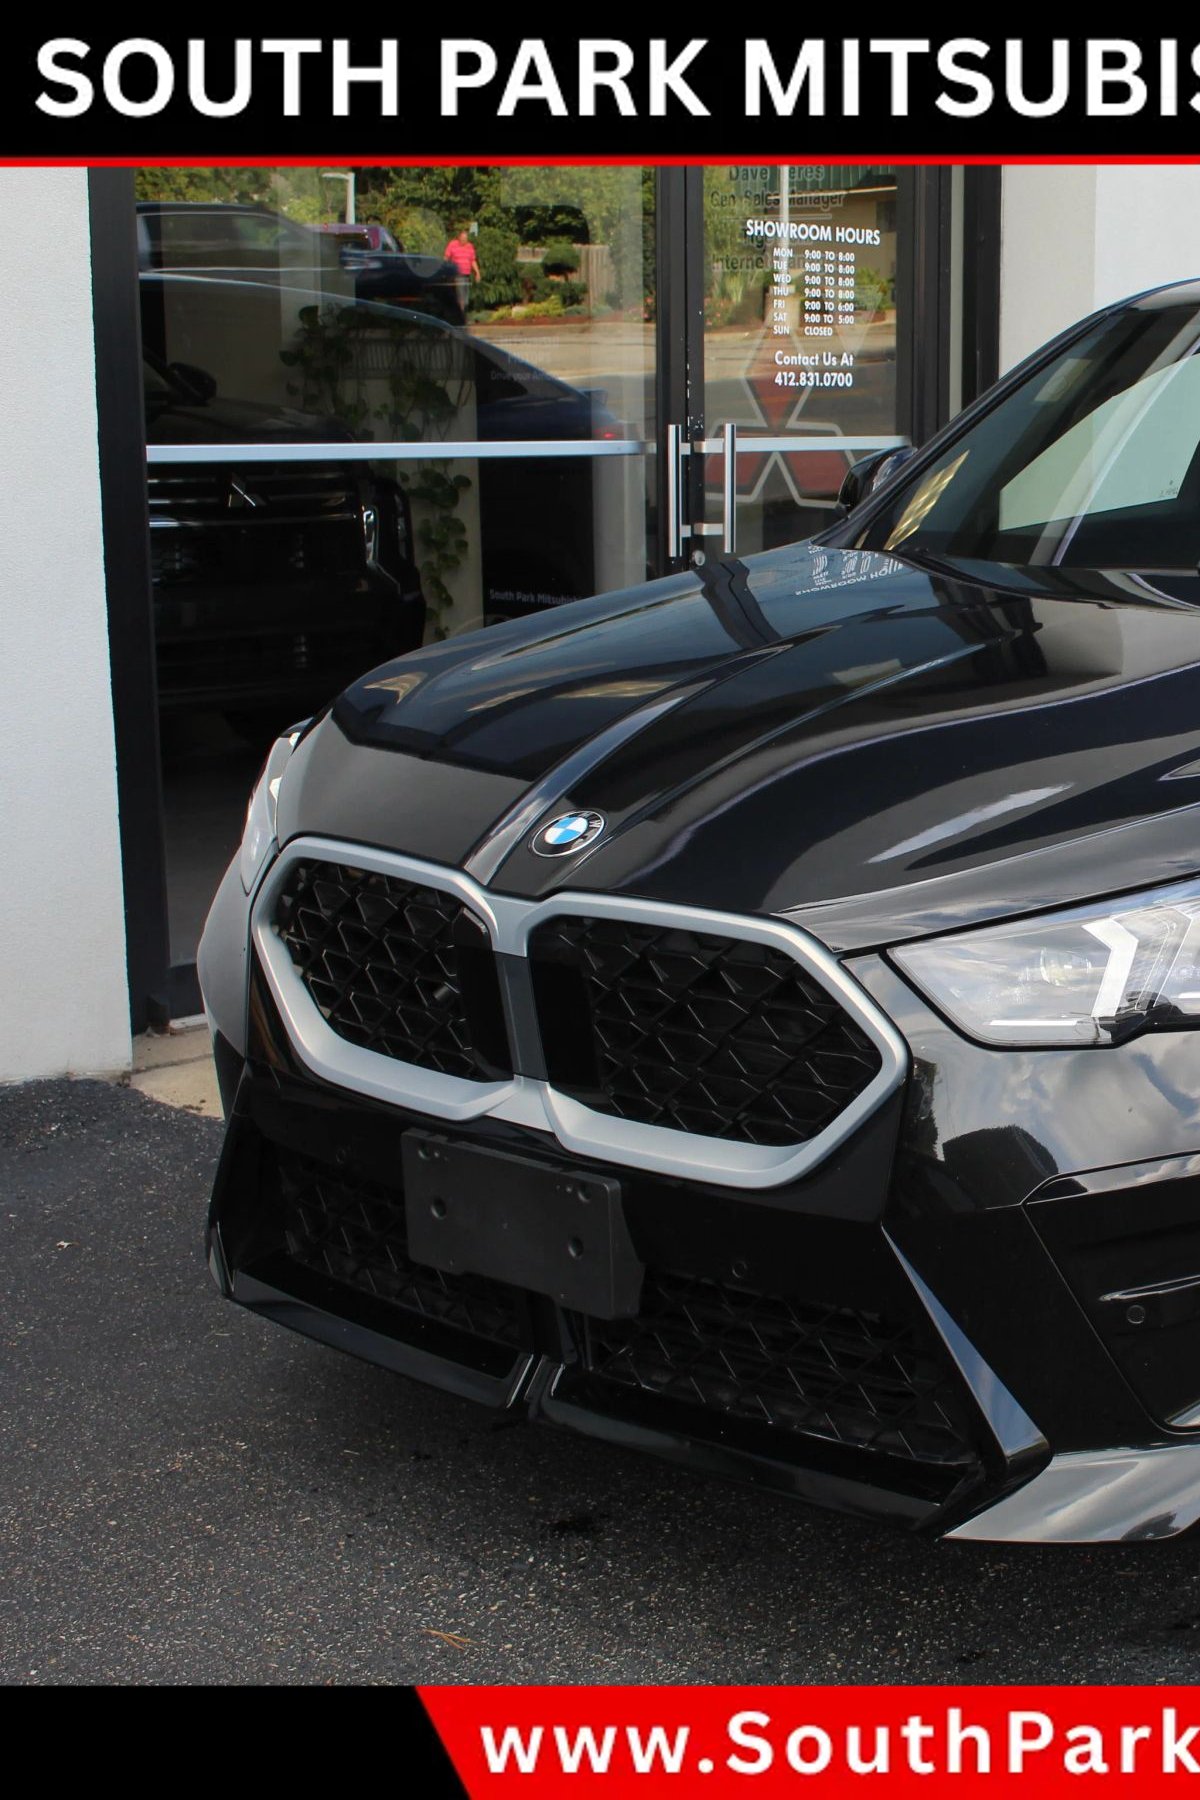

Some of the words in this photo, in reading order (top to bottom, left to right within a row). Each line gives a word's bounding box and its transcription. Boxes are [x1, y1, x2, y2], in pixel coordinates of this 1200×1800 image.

[746, 219, 832, 242] SHOWROOM
[836, 226, 881, 246] HOURS
[773, 247, 793, 257] MON
[804, 249, 821, 260] 9:00
[824, 251, 835, 260] TO
[838, 252, 855, 262] 8:00
[773, 260, 788, 270] TUE
[804, 262, 821, 272] 9:00
[824, 263, 835, 273] TO
[838, 265, 855, 275] 8:00
[773, 273, 792, 283] WED
[804, 275, 821, 285] 9:00
[824, 276, 835, 286] TO
[838, 277, 855, 287] 8:00
[773, 286, 789, 296] THU
[804, 288, 821, 298] 9:00
[824, 289, 835, 299] TO
[838, 290, 855, 299] 8:00
[773, 299, 785, 309] FRI
[804, 301, 821, 311] 9:00
[824, 301, 835, 311] TO
[838, 302, 855, 312] 6:00
[773, 312, 787, 322] SAT
[804, 313, 820, 323] 9:00
[823, 314, 834, 324] TO
[838, 315, 855, 324] 5:00
[773, 325, 790, 335] SUN
[804, 326, 833, 336] CLOSED
[774, 350, 819, 366] Contact
[822, 351, 837, 367] Us
[840, 352, 854, 367] At
[774, 371, 853, 387] 412.831.0700
